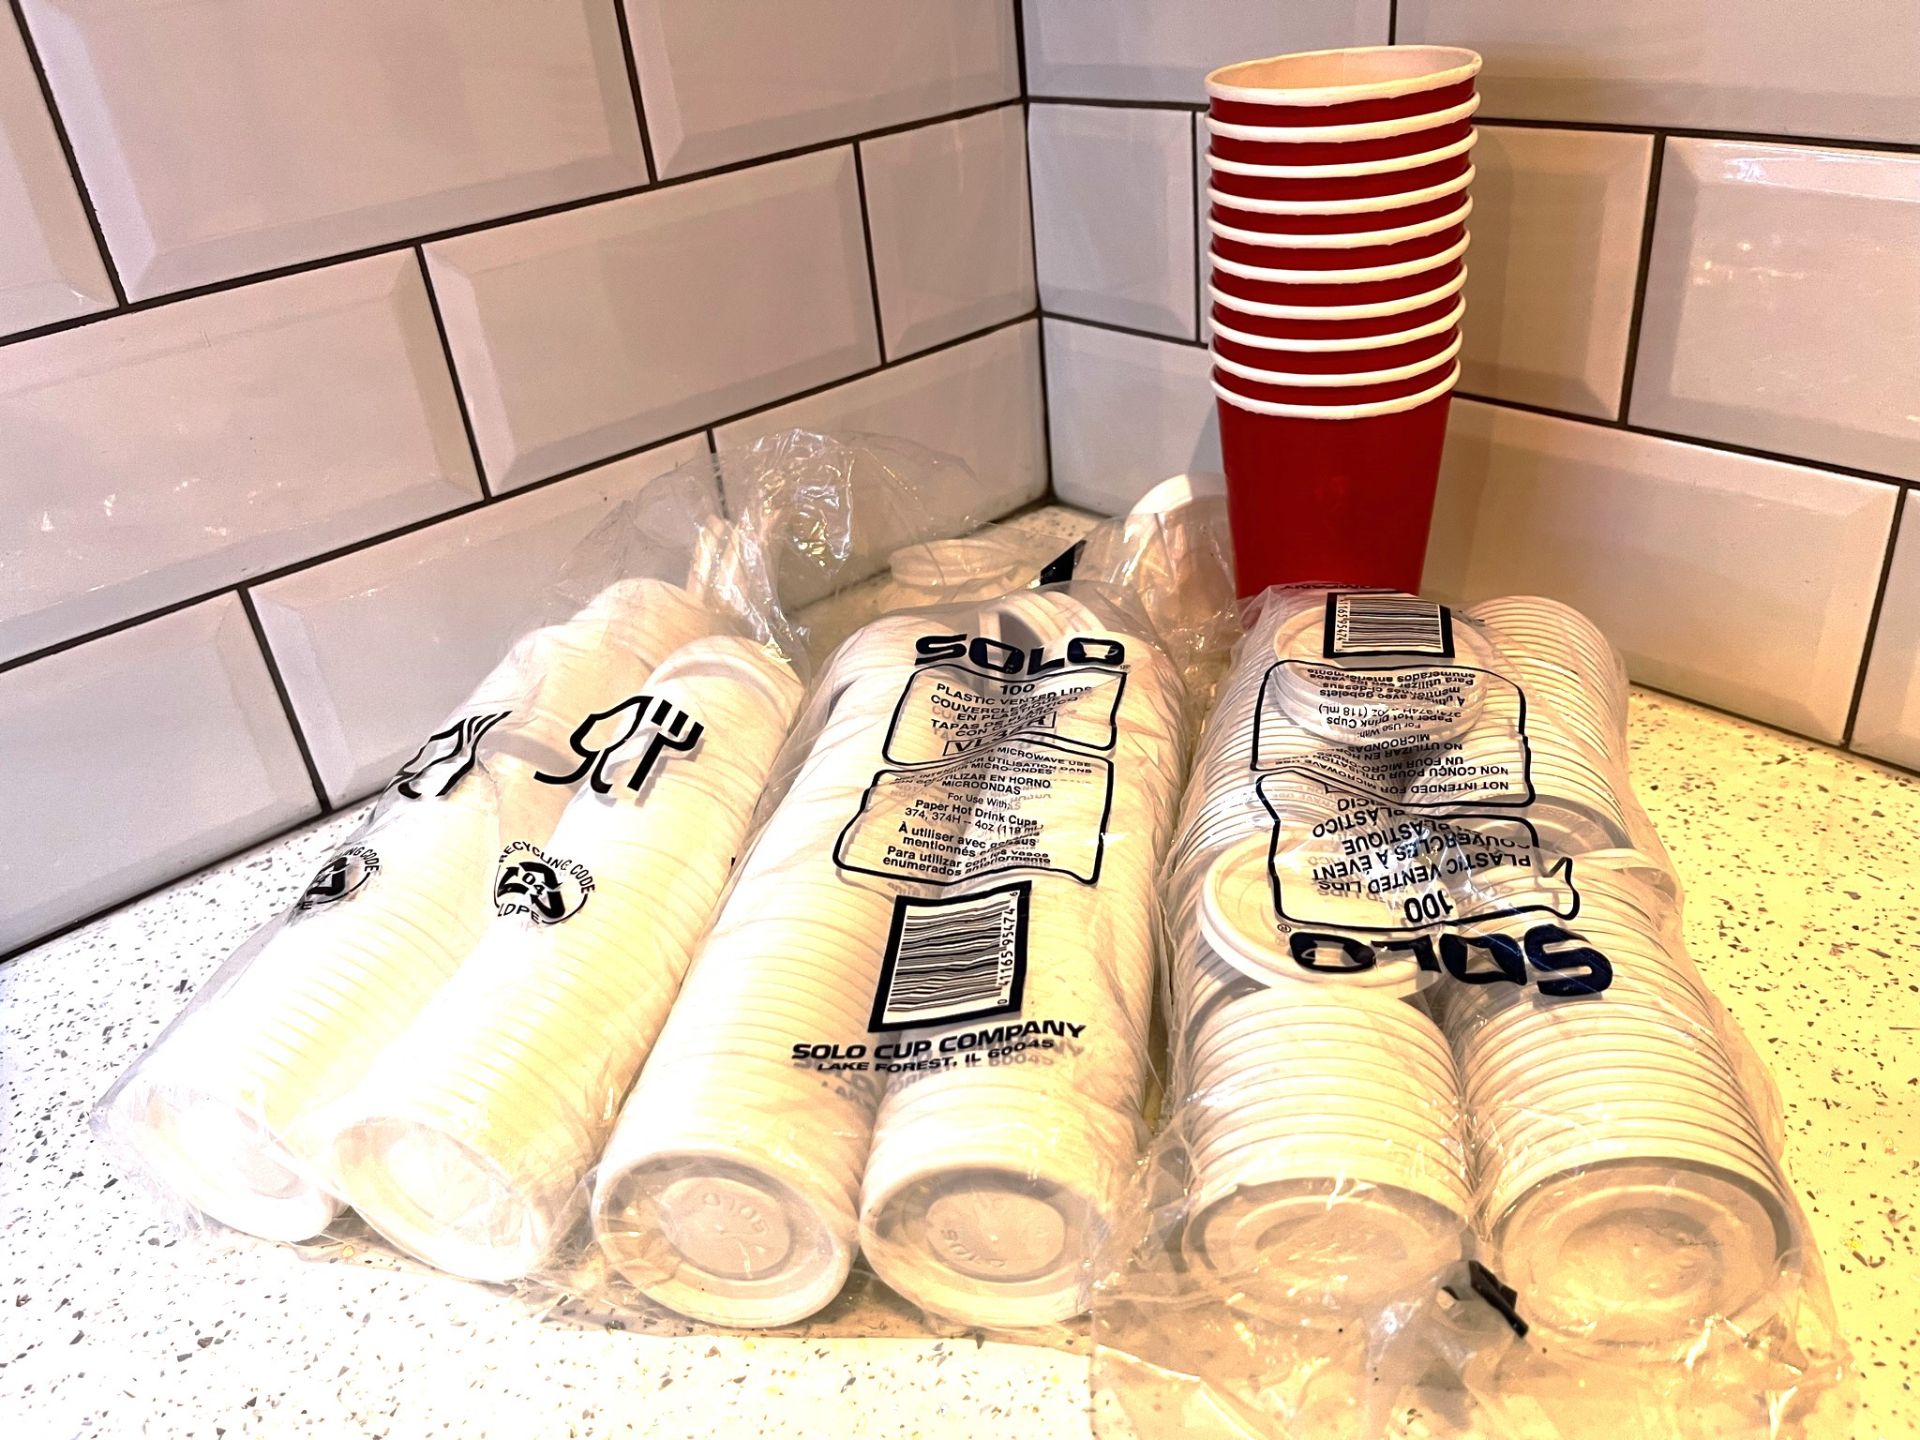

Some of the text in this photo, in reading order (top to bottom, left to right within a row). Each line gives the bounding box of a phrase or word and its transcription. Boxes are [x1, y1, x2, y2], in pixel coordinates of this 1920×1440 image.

[915, 634, 1126, 675] SOLO
[1396, 671, 1476, 683] enumerados
[1445, 677, 1474, 686] Para
[1000, 683, 1035, 697] 100
[1399, 679, 1442, 691] utilizar
[936, 682, 995, 706] PLASTIC
[999, 692, 1057, 706] VENTED
[1319, 689, 1374, 700] gobelets
[1317, 703, 1340, 716] mL)
[1342, 706, 1368, 718] (118
[956, 713, 977, 721] EN
[1326, 716, 1358, 729] Cups
[1360, 714, 1390, 728] Drink
[1417, 713, 1454, 723] Paper
[930, 719, 980, 731] TAPAS
[984, 720, 1005, 728] DE
[1382, 723, 1402, 732] Use
[955, 729, 987, 737] CON
[1357, 727, 1380, 739] With:
[1347, 733, 1431, 752] MICROONDAS
[1443, 742, 1463, 751] NO
[1364, 752, 1380, 761] EN
[1384, 742, 1440, 758] UTILIZAR
[988, 755, 1056, 770] UTILISATION
[996, 747, 1065, 765] MICROWAVE
[1068, 760, 1092, 768] USE
[1406, 756, 1442, 768] FOUR
[1444, 756, 1464, 766] UN
[970, 762, 1052, 775] MICRO-ONDES
[1304, 760, 1377, 790] MICROWAVE
[1388, 769, 1425, 779] POUR
[1428, 763, 1477, 776] CONÇU
[1480, 765, 1509, 776] NON
[941, 780, 1021, 796] MICROONDAS
[989, 774, 1006, 782] EN
[1009, 775, 1051, 789] HORNO
[1411, 782, 1478, 794] INTENDED
[1480, 781, 1509, 791] NOT
[1380, 786, 1407, 795] FOR
[947, 792, 963, 801] For
[965, 794, 983, 806] Use
[914, 799, 1038, 828] Paper Hot Drink Cups
[904, 807, 929, 821] 374,
[931, 812, 962, 825] 374H
[974, 820, 995, 832] 4oz
[996, 823, 1022, 838] (118
[898, 820, 908, 834] À
[911, 827, 954, 843] utiliser
[957, 837, 987, 850] avec
[903, 836, 977, 857] mentionnés
[887, 845, 916, 861] Para
[919, 851, 963, 869] utilizar
[965, 857, 987, 868] con
[1011, 849, 1049, 858] vasos
[1445, 851, 1532, 875] PLASTIC
[499, 841, 596, 895] RECYCLING CODE
[882, 855, 1051, 877] enumerados anteriormente
[1310, 854, 1373, 882] ÉVENT
[1367, 863, 1442, 895] VENTED
[1403, 887, 1454, 924] 100
[1289, 924, 1613, 996] SOLO
[792, 1019, 1087, 1060] SOLO CUP COMPANY
[817, 1038, 1055, 1073] LAKE FOREST, IL 60045
